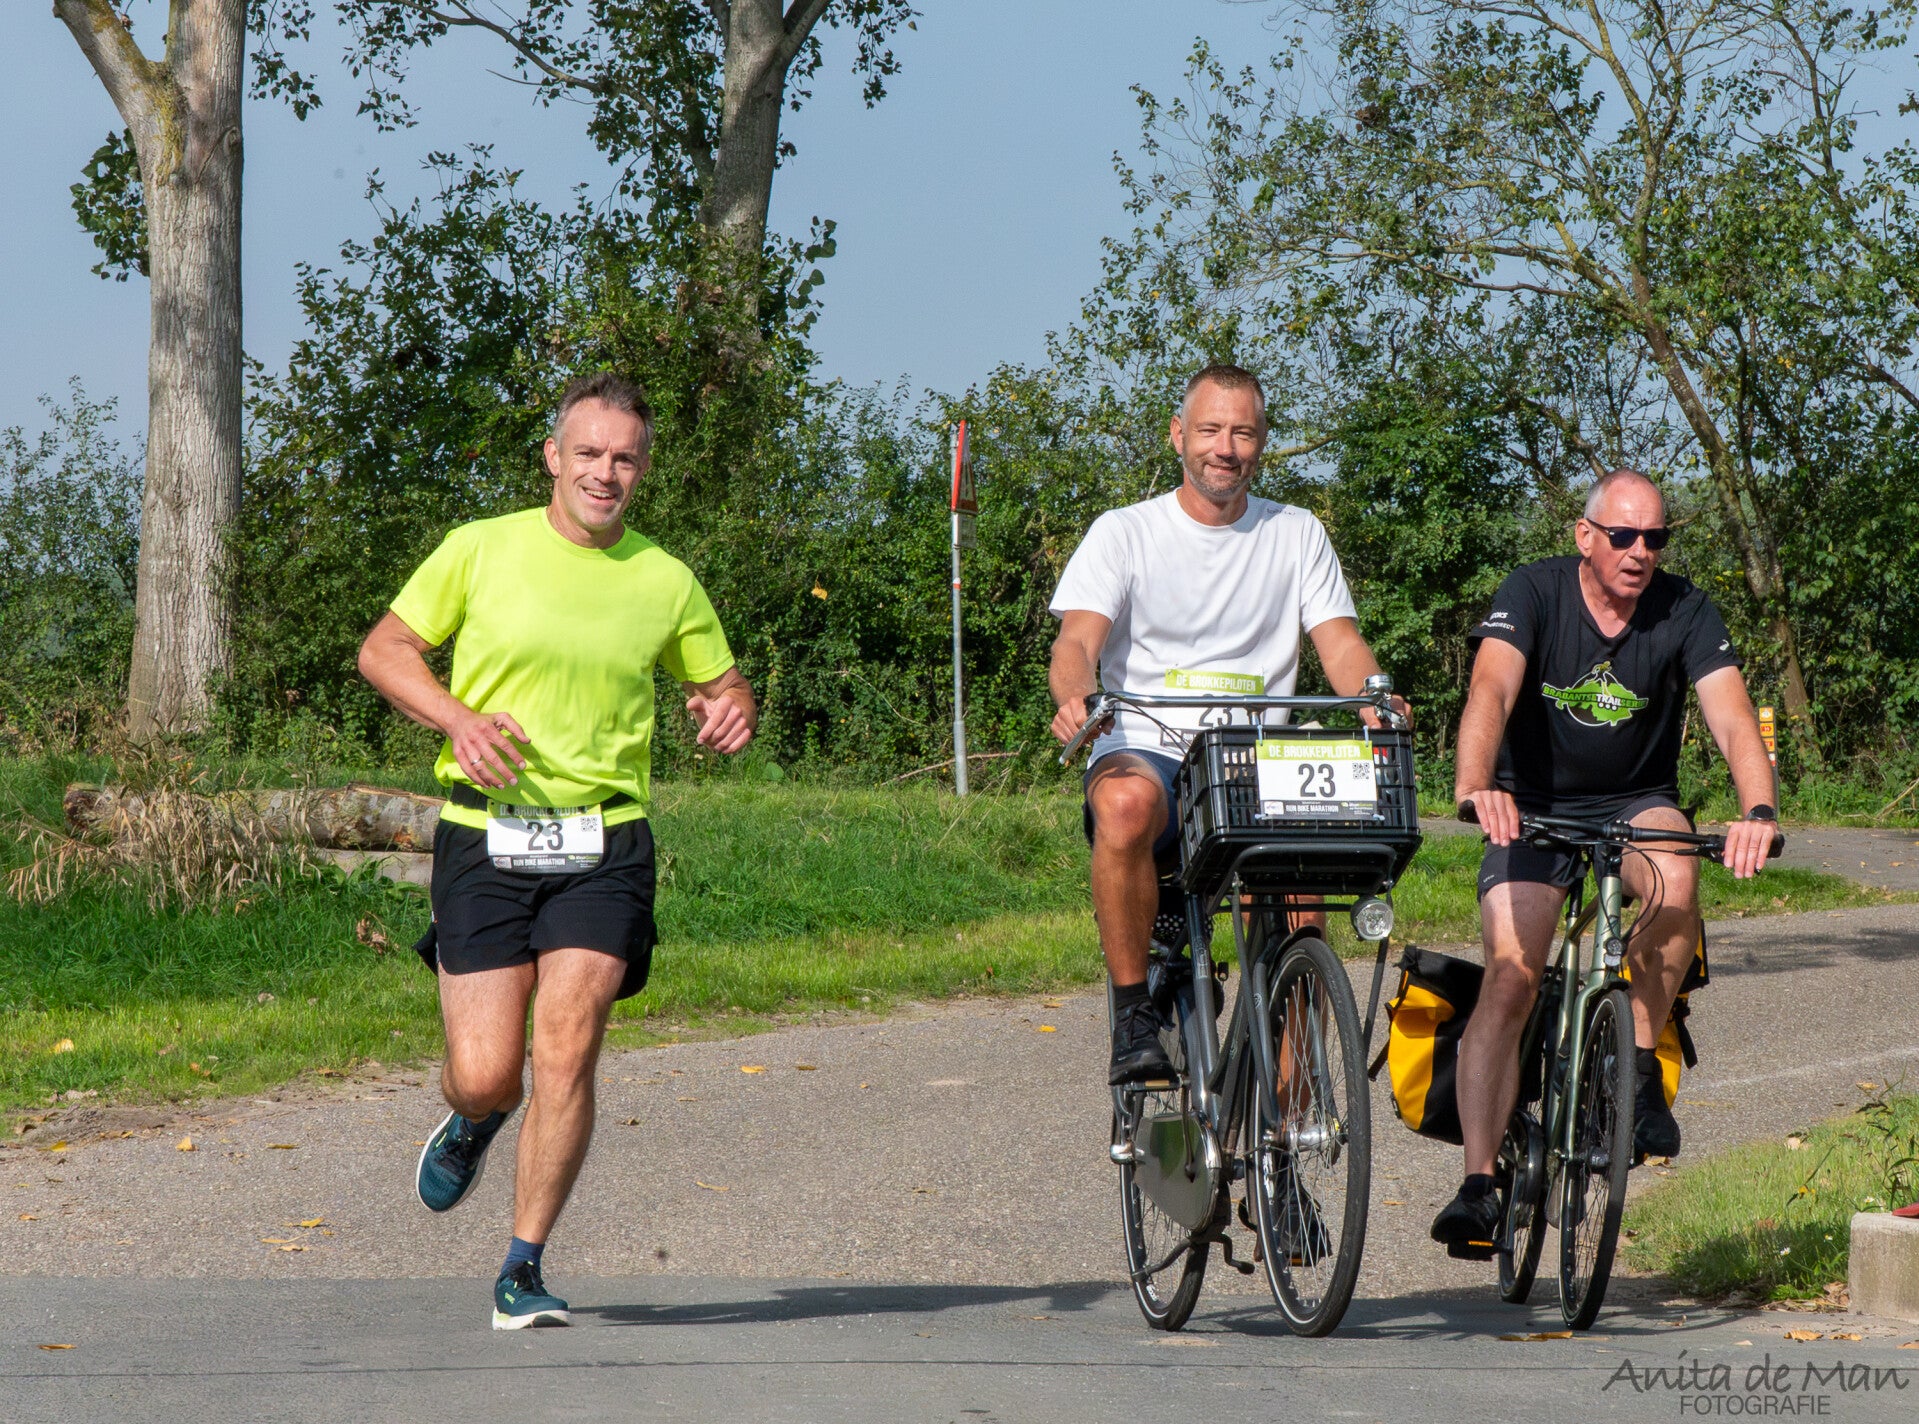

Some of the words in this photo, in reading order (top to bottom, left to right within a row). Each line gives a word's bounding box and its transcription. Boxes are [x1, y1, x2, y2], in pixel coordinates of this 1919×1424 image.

[1176, 674, 1188, 687] DE
[1189, 675, 1256, 692] BROKKEPILOTEN
[1268, 745, 1282, 758] DE
[1283, 745, 1361, 758] BROKKEPILOTEN
[1298, 763, 1336, 798] 23
[1297, 804, 1309, 812] BIKE
[1310, 804, 1339, 813] MARATHON
[527, 821, 564, 851] 23
[524, 858, 537, 866] BIKE
[537, 858, 566, 866] MARATHON
